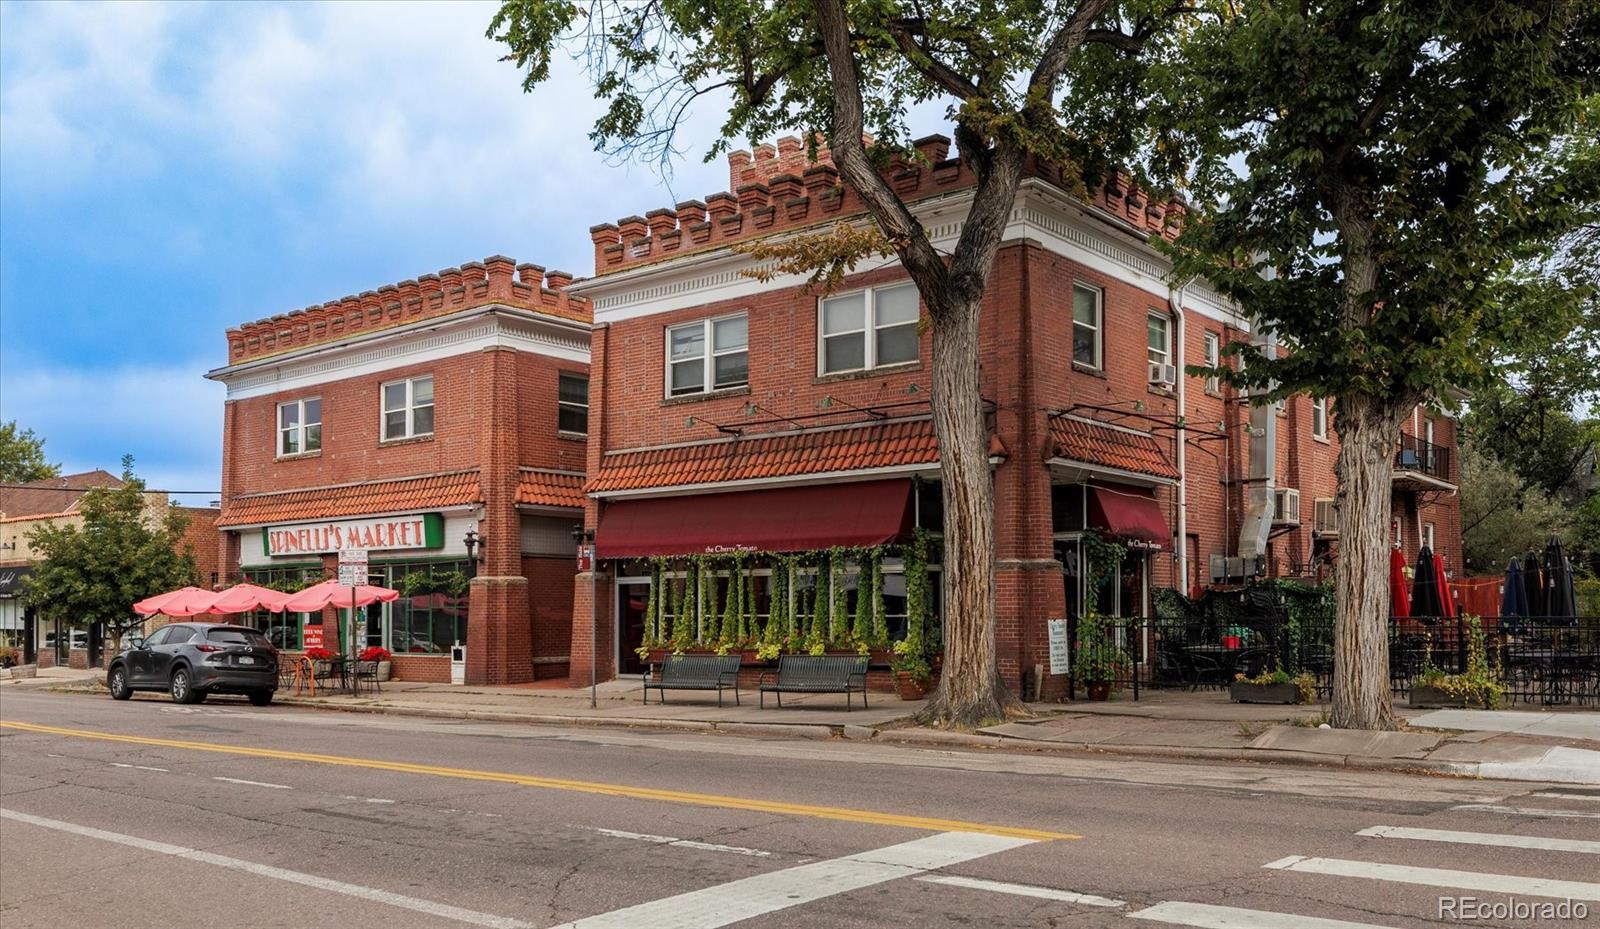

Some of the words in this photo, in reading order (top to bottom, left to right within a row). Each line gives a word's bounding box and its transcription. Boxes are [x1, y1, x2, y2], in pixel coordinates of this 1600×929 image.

[270, 523, 342, 553] SPINELLI'S
[347, 520, 423, 548] MARKET
[705, 545, 714, 553] the
[714, 545, 736, 553] Cherry
[1134, 539, 1148, 549] Cherry
[1148, 540, 1162, 549] Tomato
